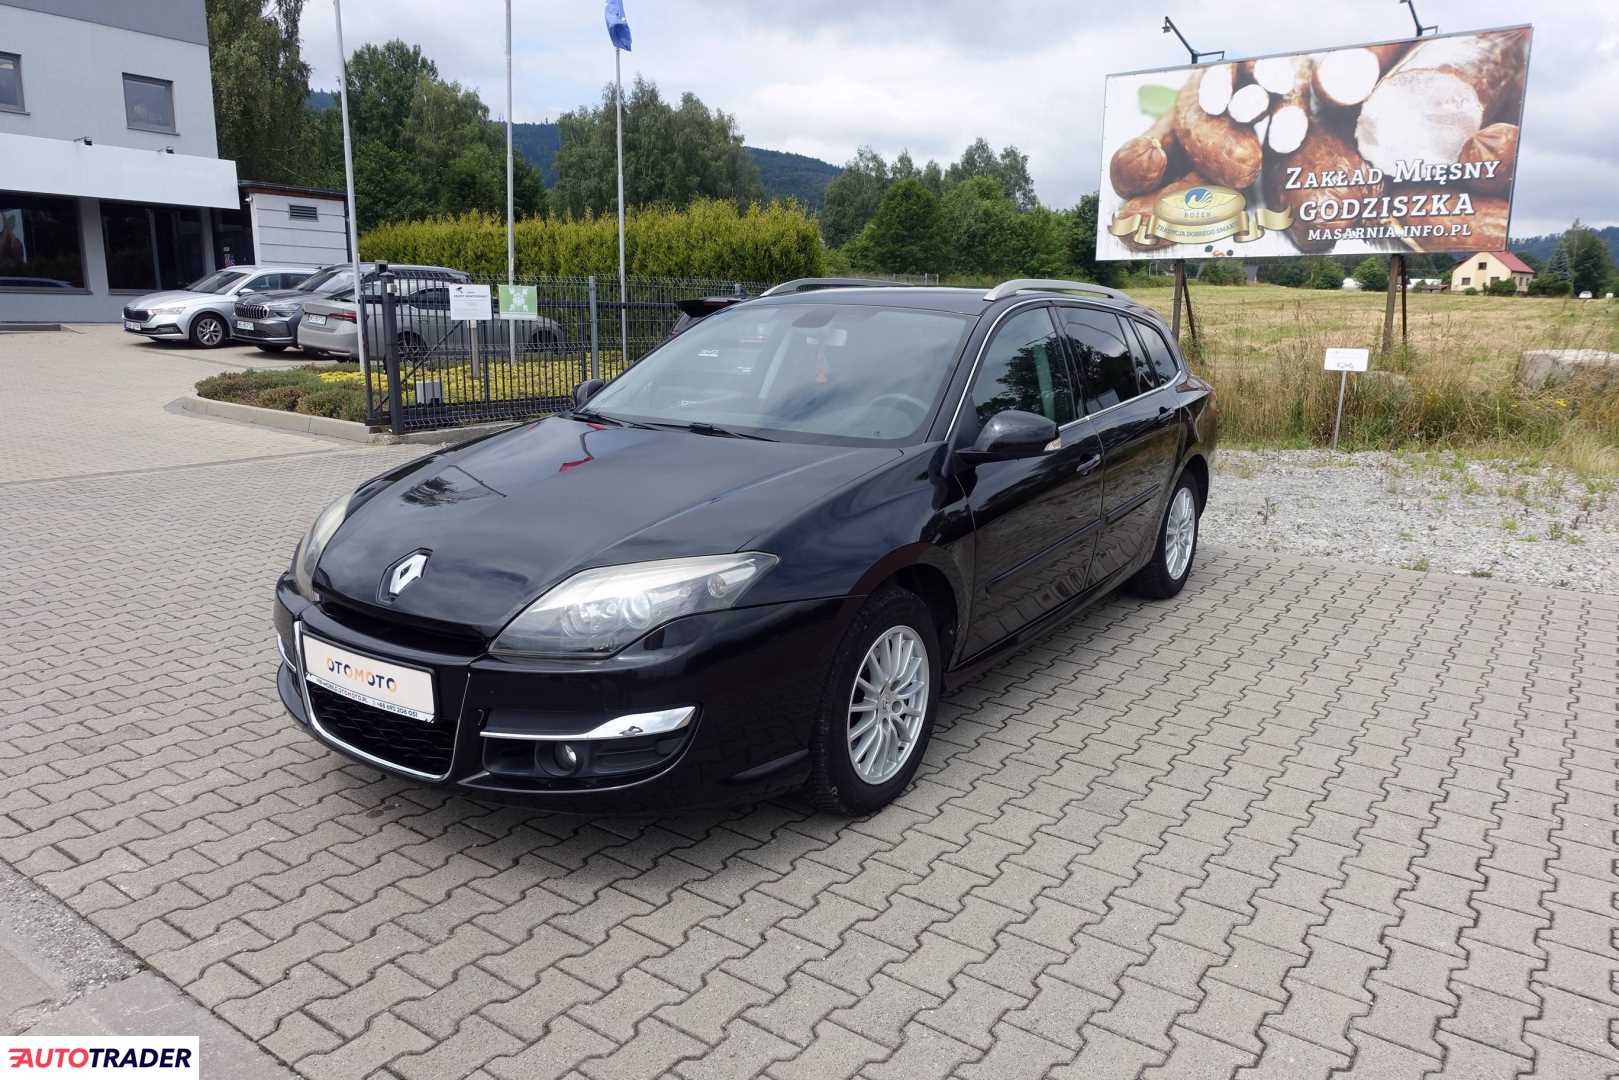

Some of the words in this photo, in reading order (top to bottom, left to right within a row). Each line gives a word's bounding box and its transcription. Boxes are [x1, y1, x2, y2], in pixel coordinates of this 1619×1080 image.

[1285, 166, 1384, 190] ZAKŁAD
[1393, 159, 1500, 186] MIĘSNY
[1299, 193, 1475, 221] GODZISZKA
[1308, 223, 1472, 241] MASARNIA.INFO.PL
[325, 656, 399, 692] OTOMOTO
